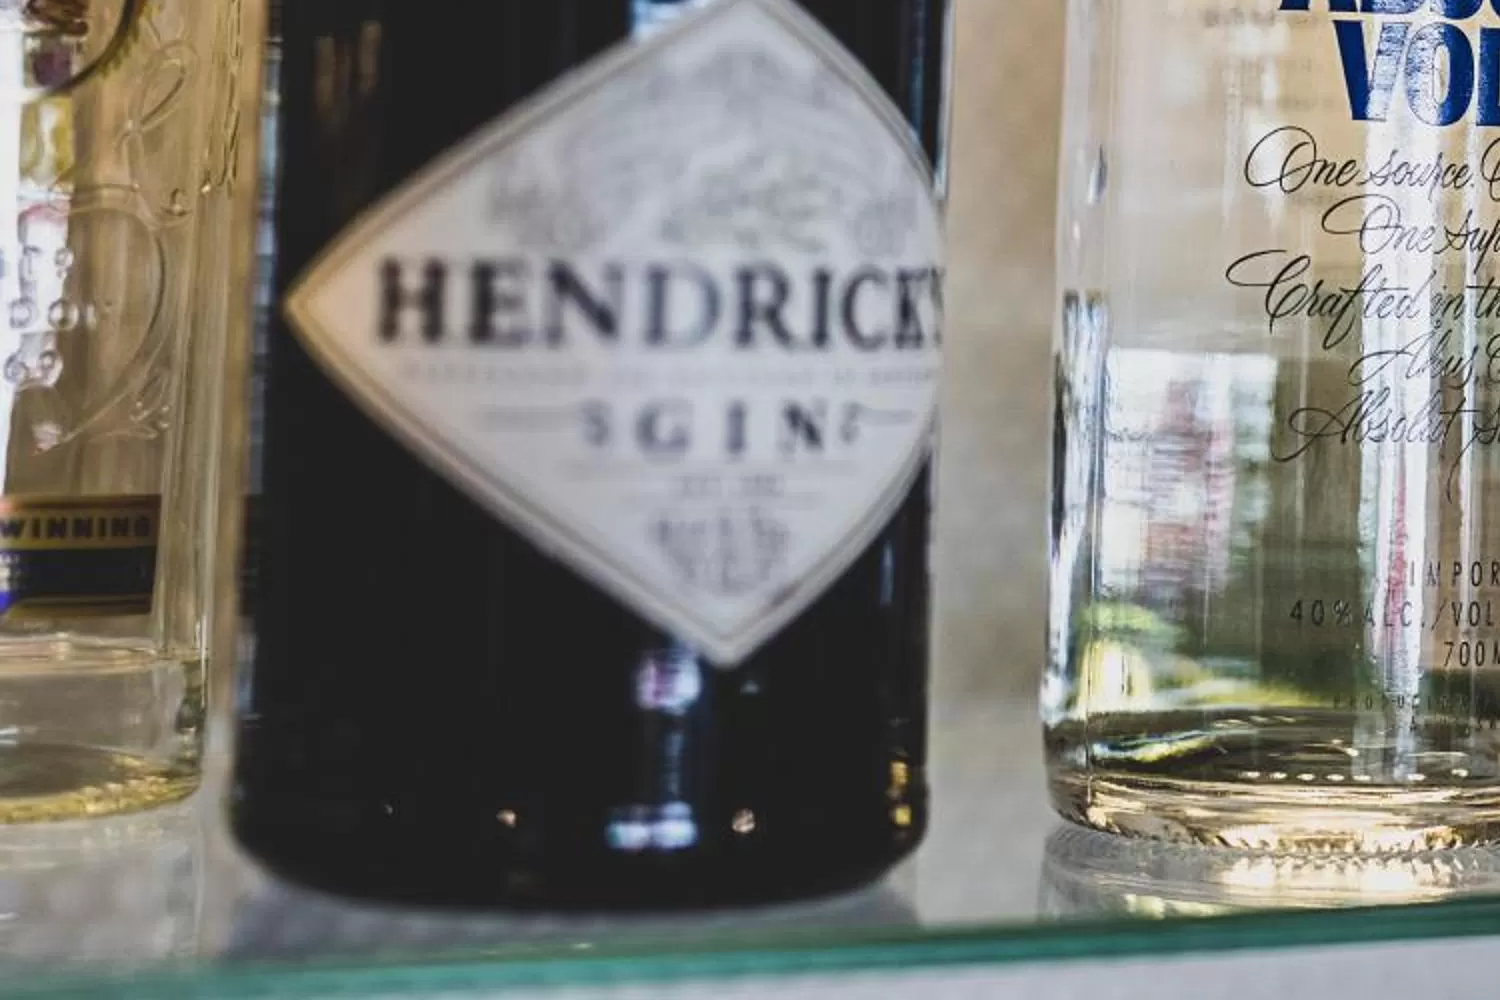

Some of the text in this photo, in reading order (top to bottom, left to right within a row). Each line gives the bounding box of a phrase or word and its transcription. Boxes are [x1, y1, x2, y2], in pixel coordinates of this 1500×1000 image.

[1245, 126, 1361, 194] One
[1321, 193, 1437, 255] One
[1225, 250, 1438, 351] Crafted
[634, 398, 830, 464] GIN
[1271, 387, 1483, 463] Absolut
[1290, 600, 1350, 627] 40%
